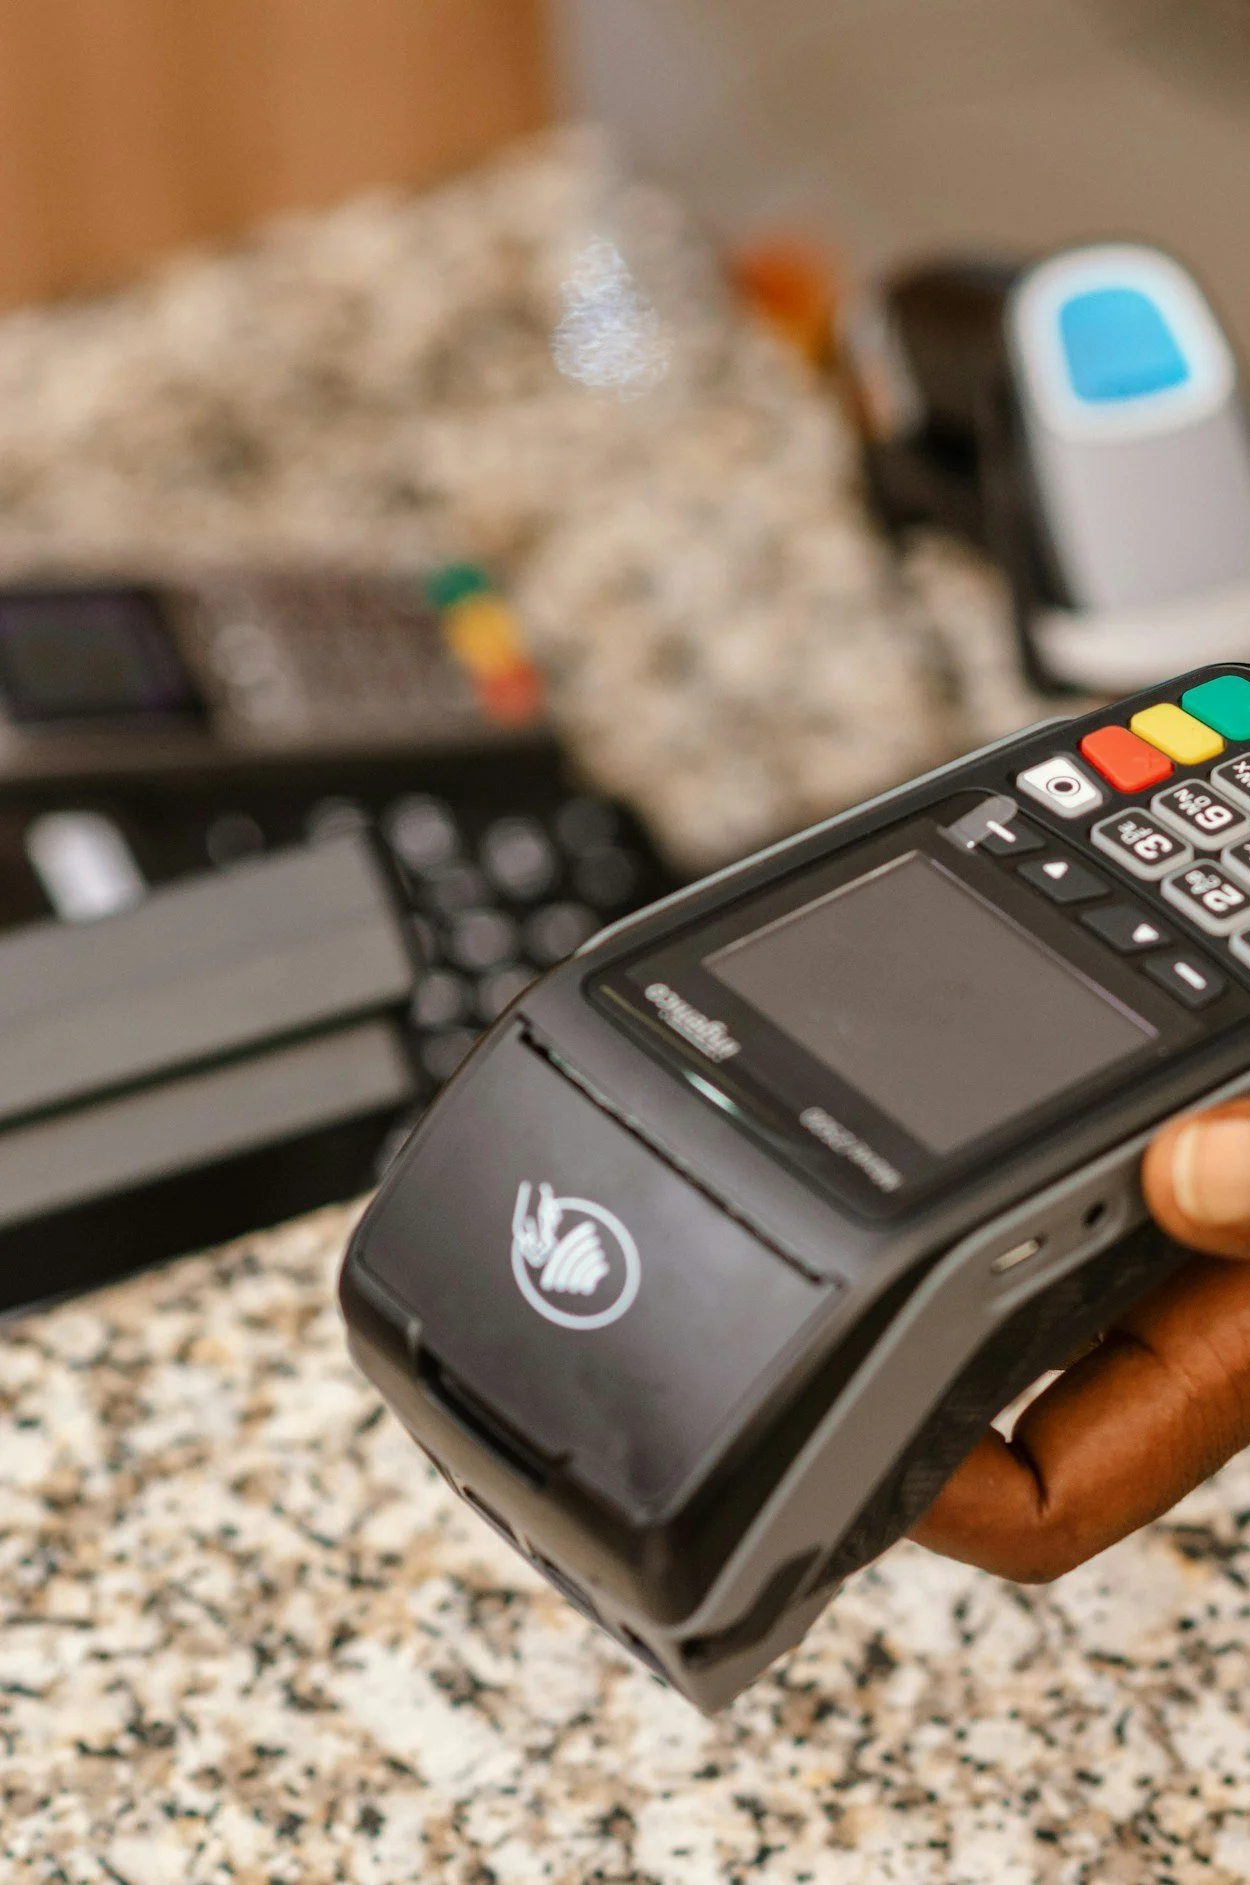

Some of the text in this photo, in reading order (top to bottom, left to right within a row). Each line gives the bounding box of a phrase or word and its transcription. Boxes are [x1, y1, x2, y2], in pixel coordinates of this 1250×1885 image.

[1195, 804, 1233, 830] 6
[1134, 833, 1173, 860] 3
[1203, 884, 1245, 912] 2
